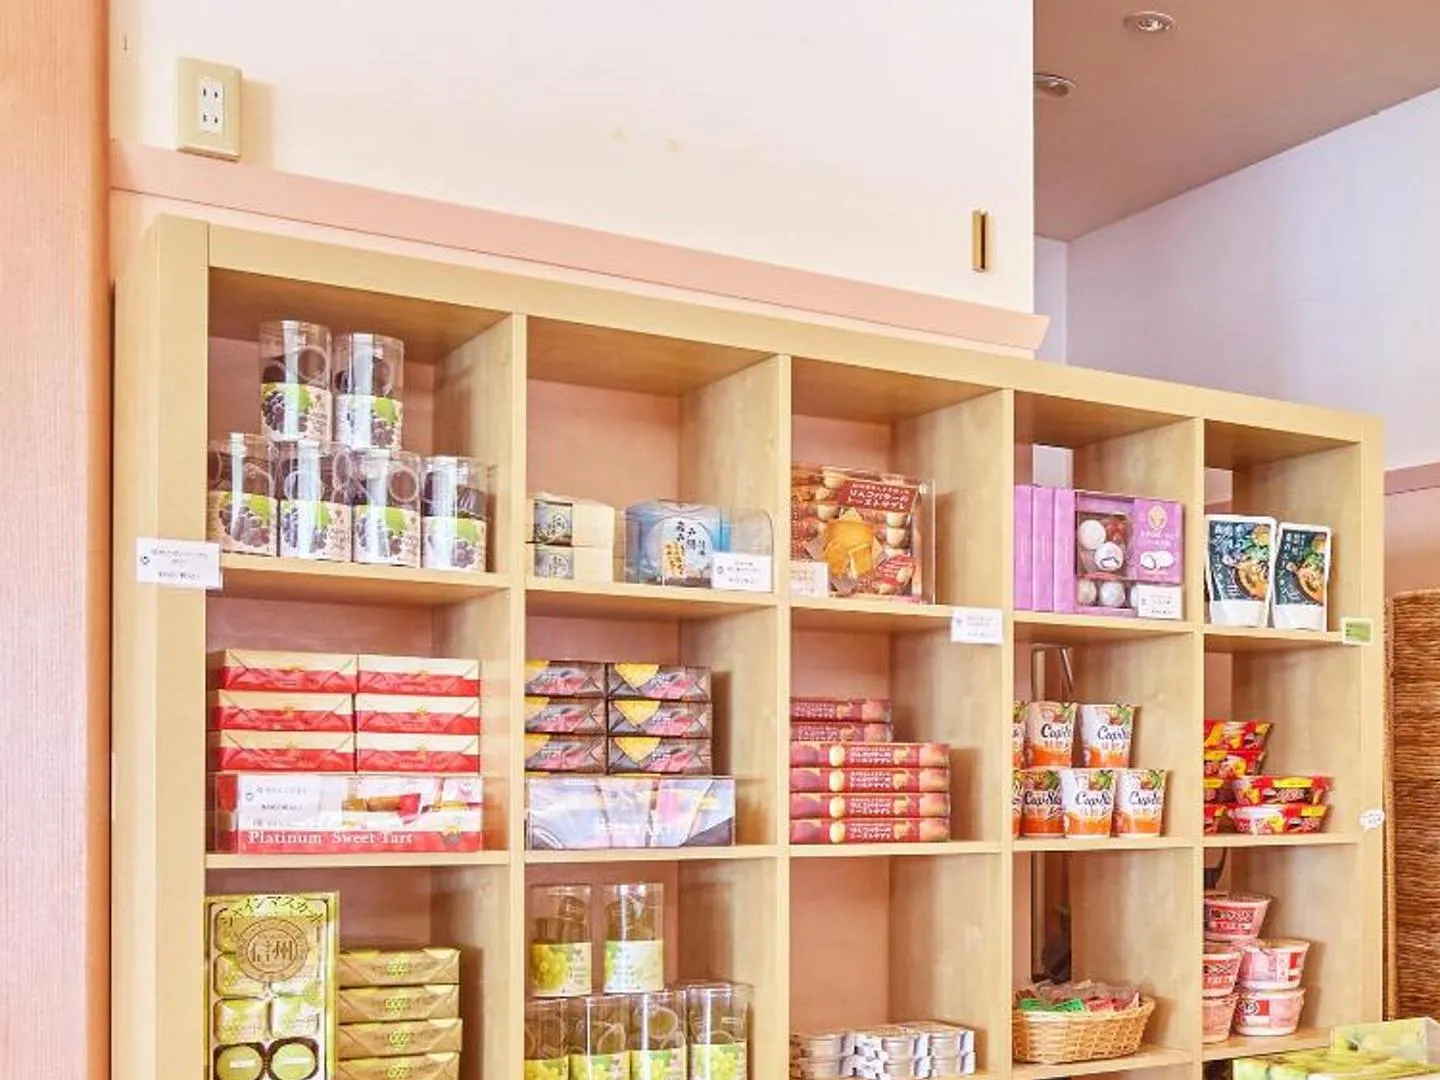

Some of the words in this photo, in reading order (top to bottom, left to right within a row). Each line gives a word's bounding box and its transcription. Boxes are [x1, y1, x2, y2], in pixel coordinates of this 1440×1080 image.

[249, 831, 322, 845] Platinum
[332, 832, 374, 845] Sweet
[381, 832, 413, 845] Tart
[251, 938, 294, 963] 信州
